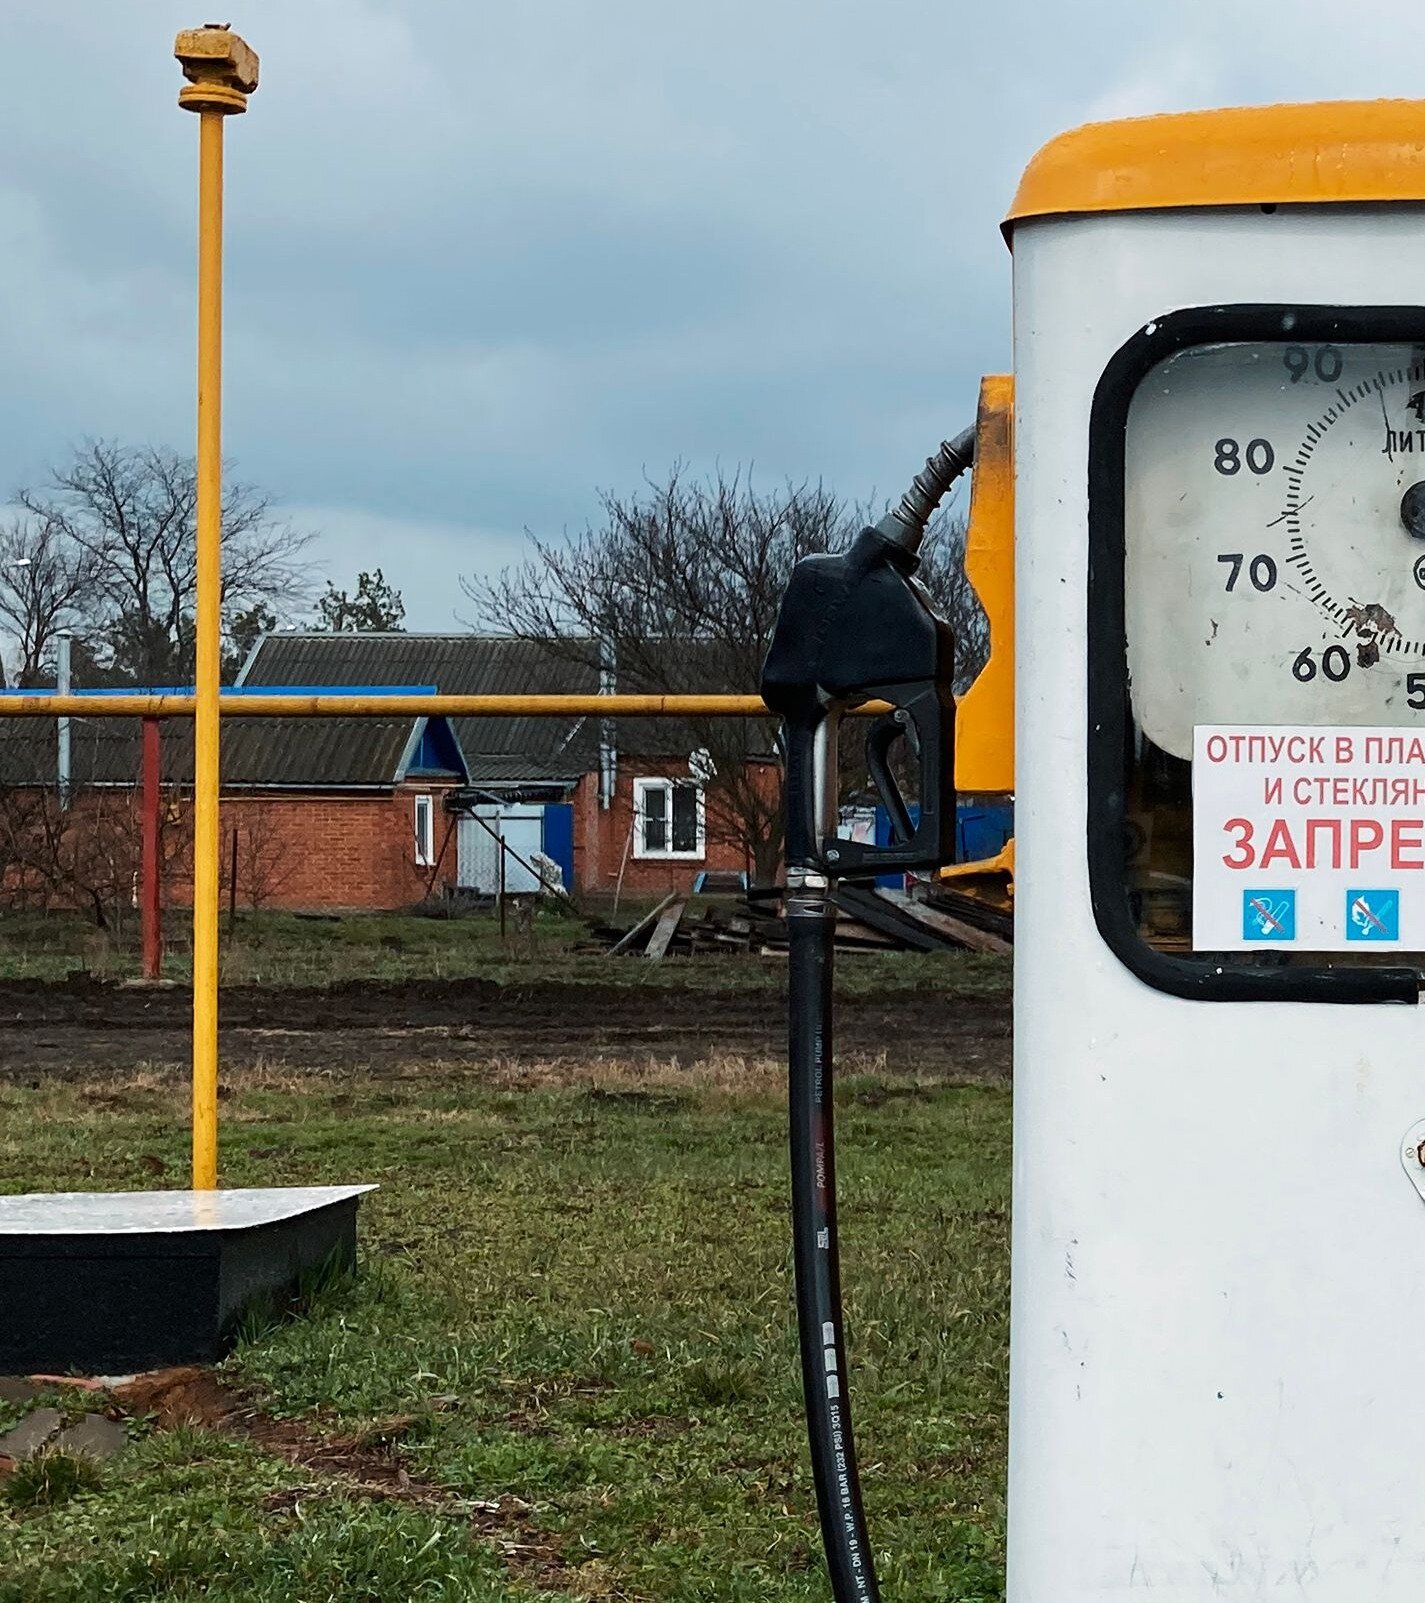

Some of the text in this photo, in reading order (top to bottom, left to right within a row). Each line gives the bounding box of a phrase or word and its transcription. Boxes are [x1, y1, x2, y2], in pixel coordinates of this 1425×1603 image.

[1284, 345, 1343, 384] 90
[1213, 439, 1275, 476] 80
[1217, 553, 1278, 593] 70
[1291, 645, 1351, 683] 60
[1207, 735, 1324, 764] ОТПУСК
[1335, 736, 1353, 765] В
[1264, 777, 1283, 804] И
[832, 1430, 843, 1451] PSI)
[835, 1451, 847, 1472] (232
[838, 1473, 849, 1496] BAR
[848, 1539, 858, 1551] 19
[851, 1552, 862, 1568] DN
